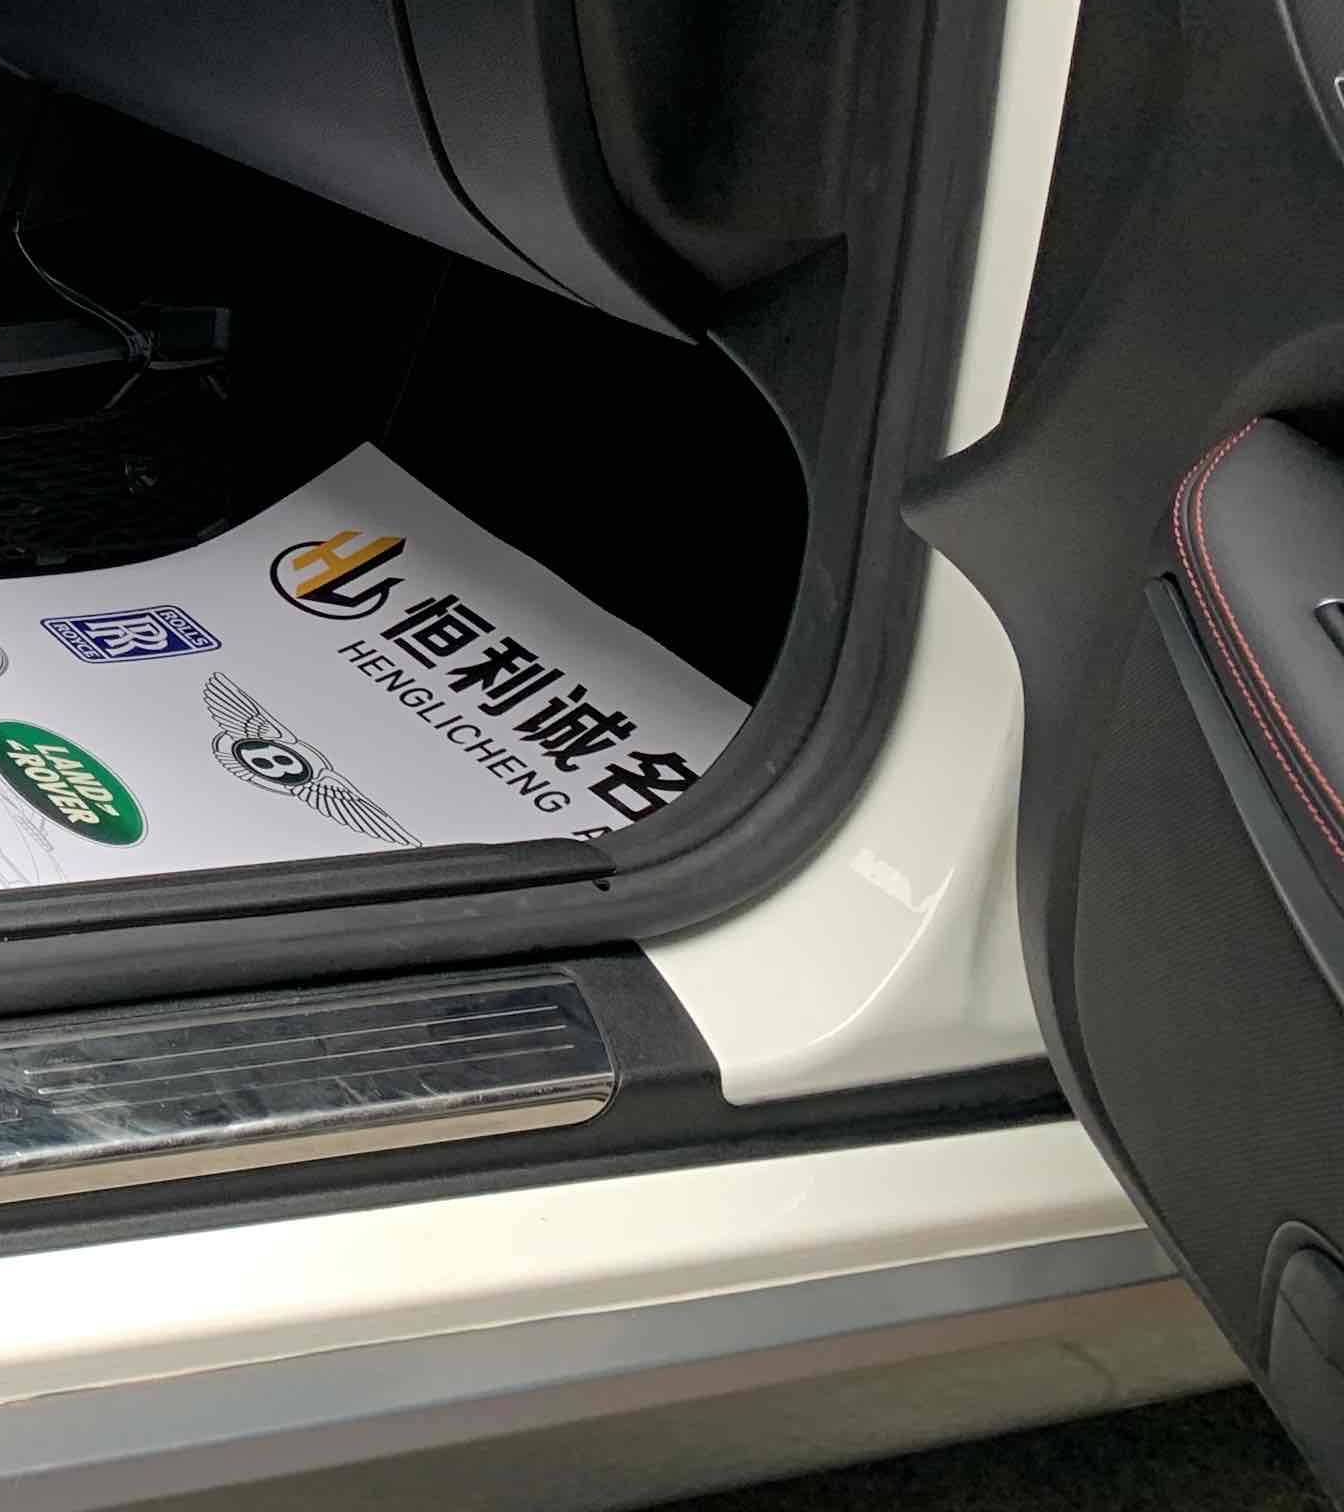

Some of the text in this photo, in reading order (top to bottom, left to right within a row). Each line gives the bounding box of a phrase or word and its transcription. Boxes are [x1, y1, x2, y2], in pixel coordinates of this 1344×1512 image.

[50, 620, 102, 660] ROYCE
[159, 608, 210, 649] ROLLS
[336, 639, 572, 815] HENGLICHENG
[10, 748, 100, 826] ROVER
[33, 742, 113, 810] LAND
